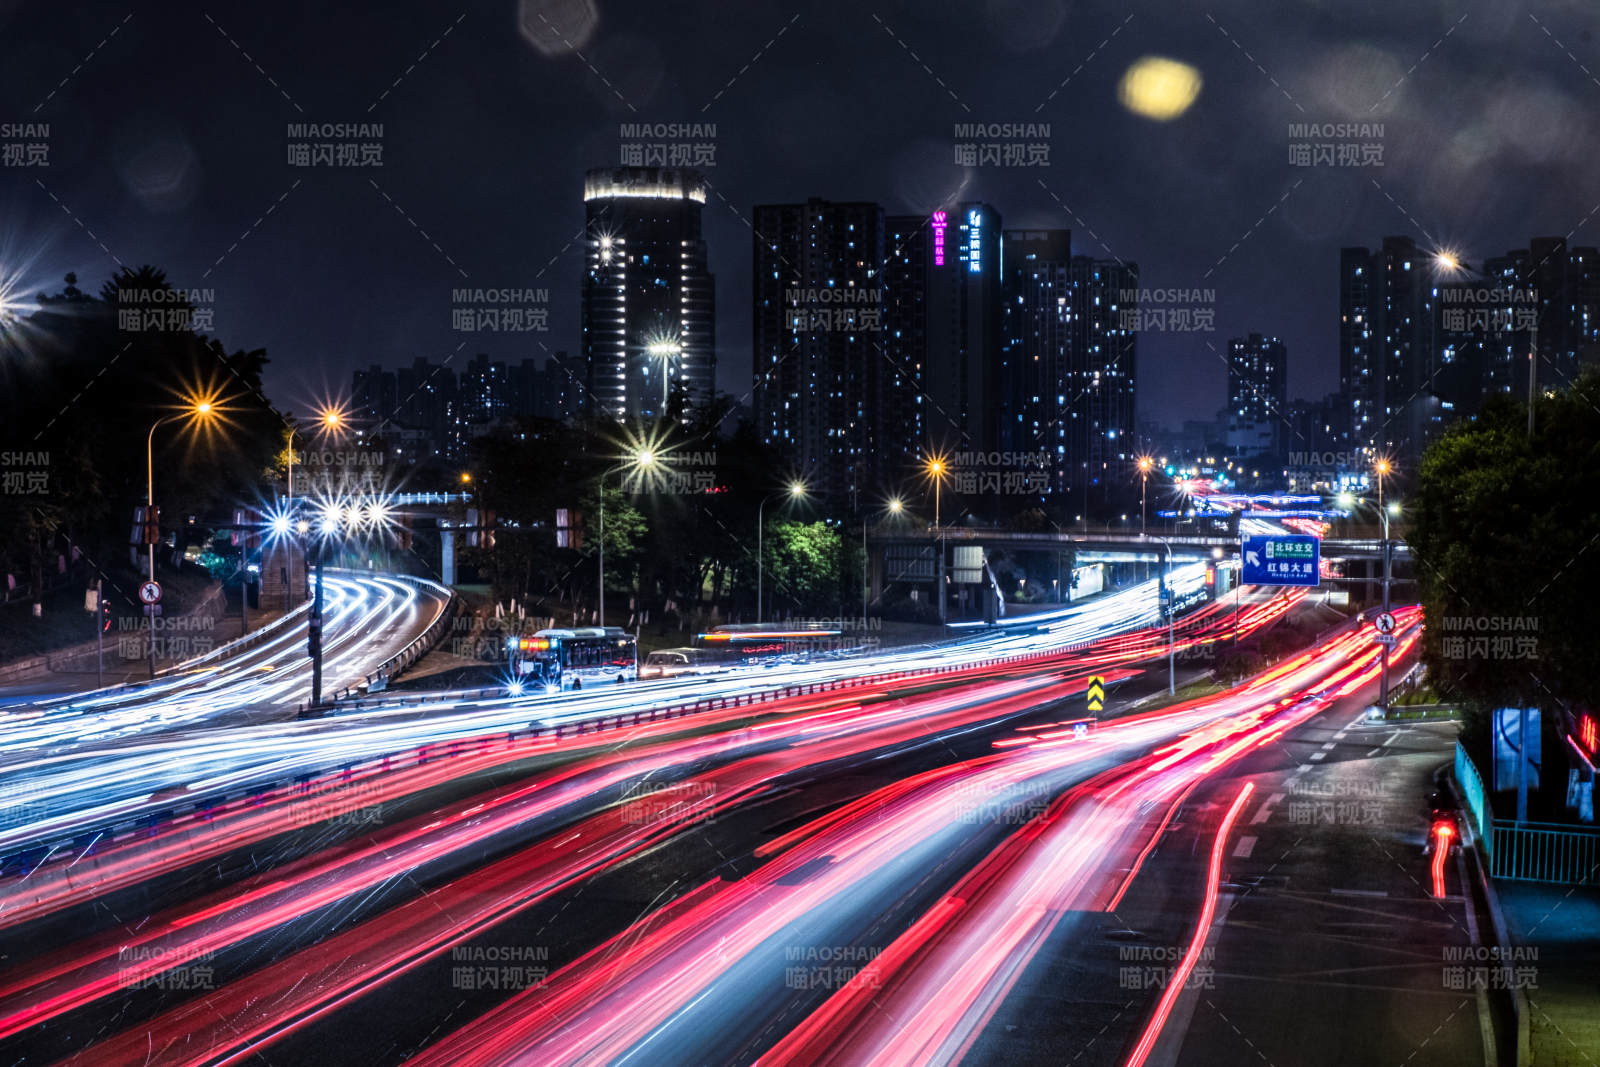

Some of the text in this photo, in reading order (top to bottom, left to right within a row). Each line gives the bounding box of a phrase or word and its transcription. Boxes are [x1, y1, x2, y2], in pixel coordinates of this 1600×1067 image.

[1275, 542, 1313, 553] 北环立交
[1267, 562, 1313, 573] 红锦大道
